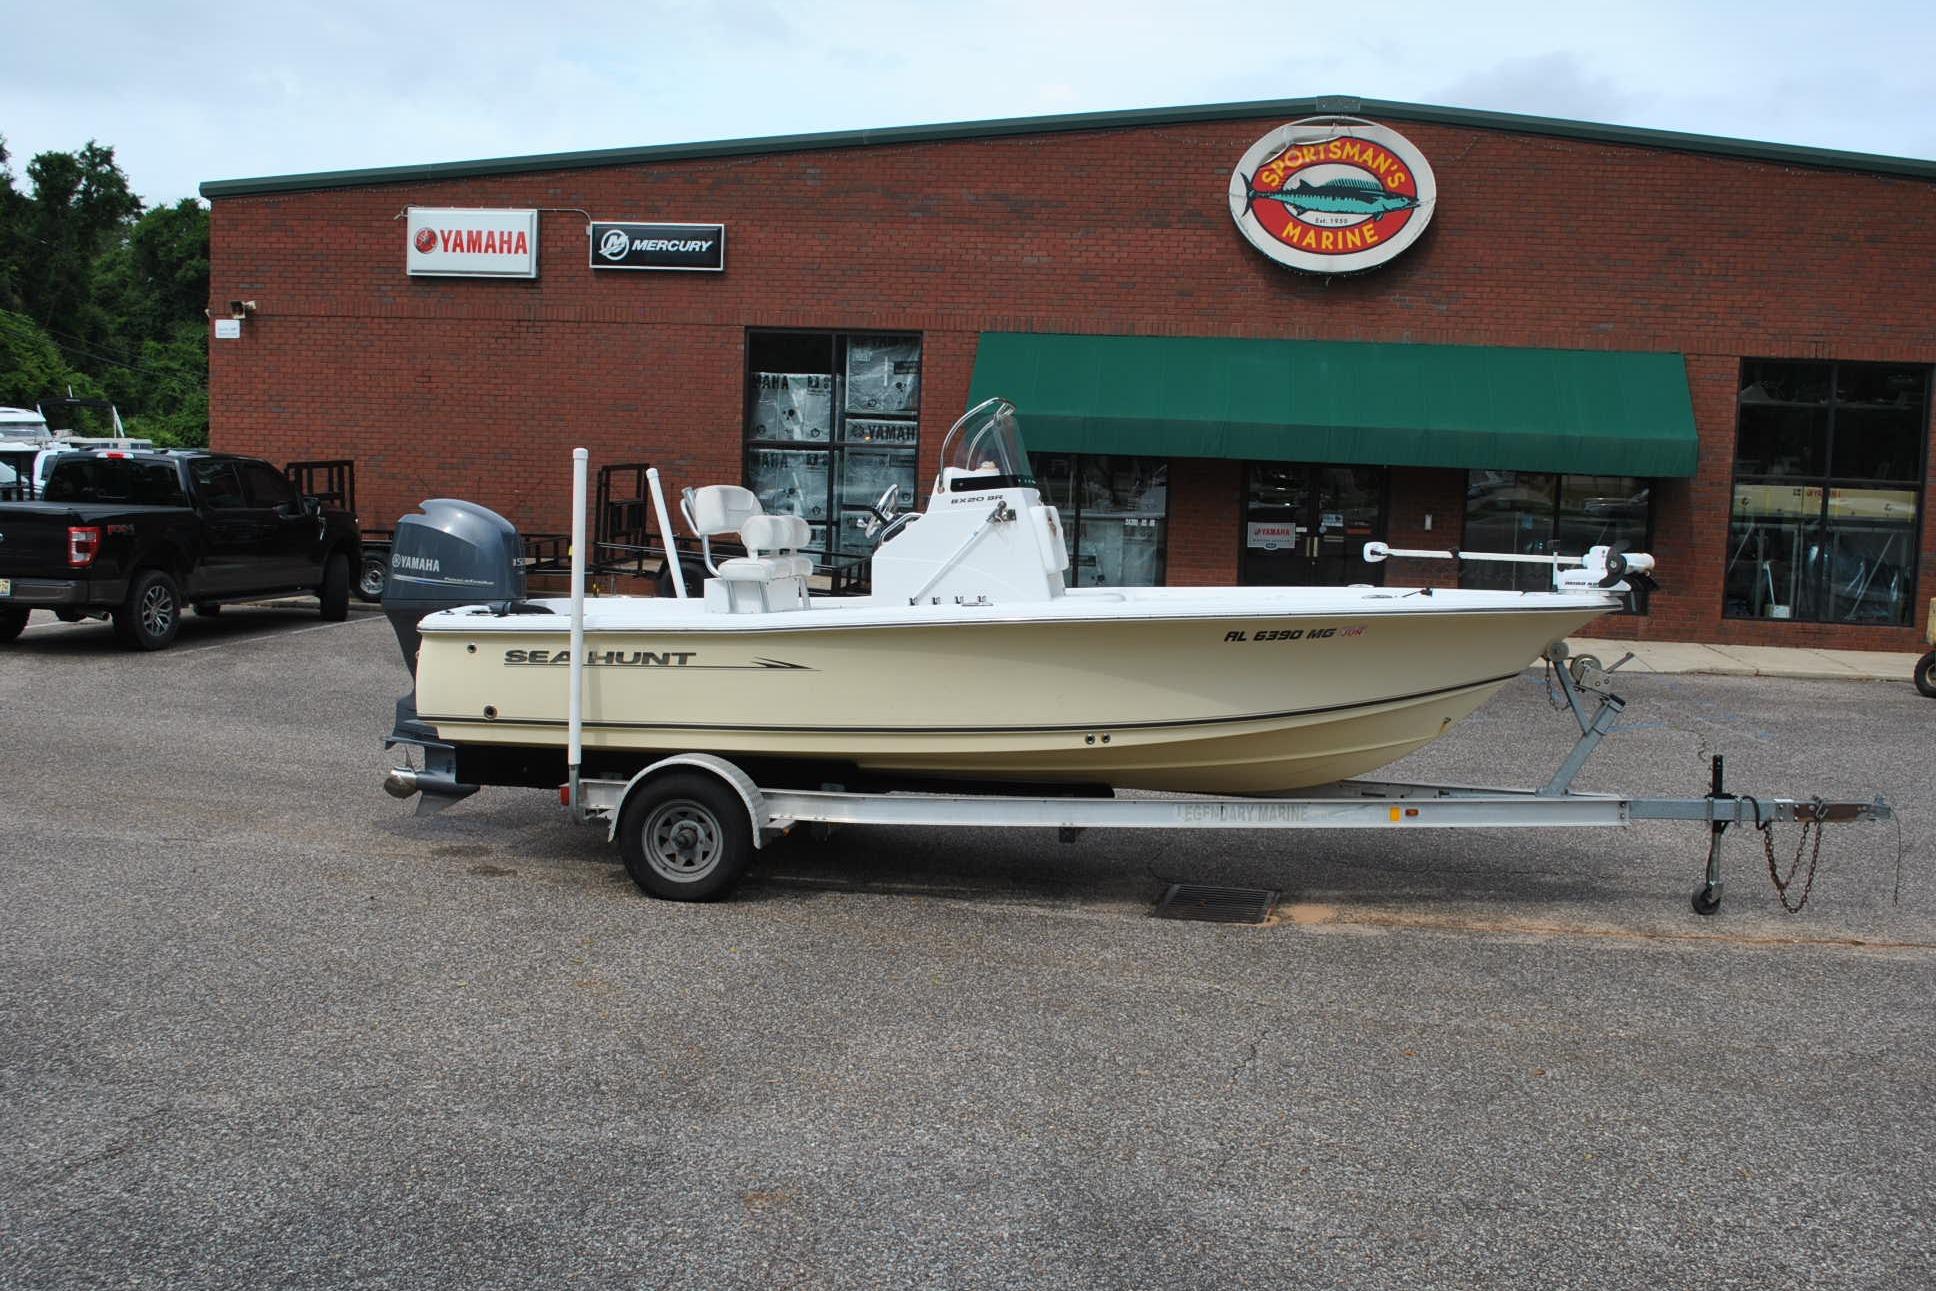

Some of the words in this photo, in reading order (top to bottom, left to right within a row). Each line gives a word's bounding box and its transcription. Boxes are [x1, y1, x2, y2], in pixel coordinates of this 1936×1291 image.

[1261, 140, 1406, 189] SPORTSMAN'S
[440, 229, 528, 255] YAMAHA
[1282, 222, 1379, 250] MARINE
[631, 239, 713, 252] MERCURY
[1262, 527, 1290, 537] YAMAHA
[401, 554, 440, 572] YAMAHA
[1224, 630, 1248, 642] AL
[1253, 629, 1304, 641] 6390
[1306, 628, 1337, 639] MG
[587, 650, 697, 665] HUNT
[1257, 803, 1310, 822] MARINE
